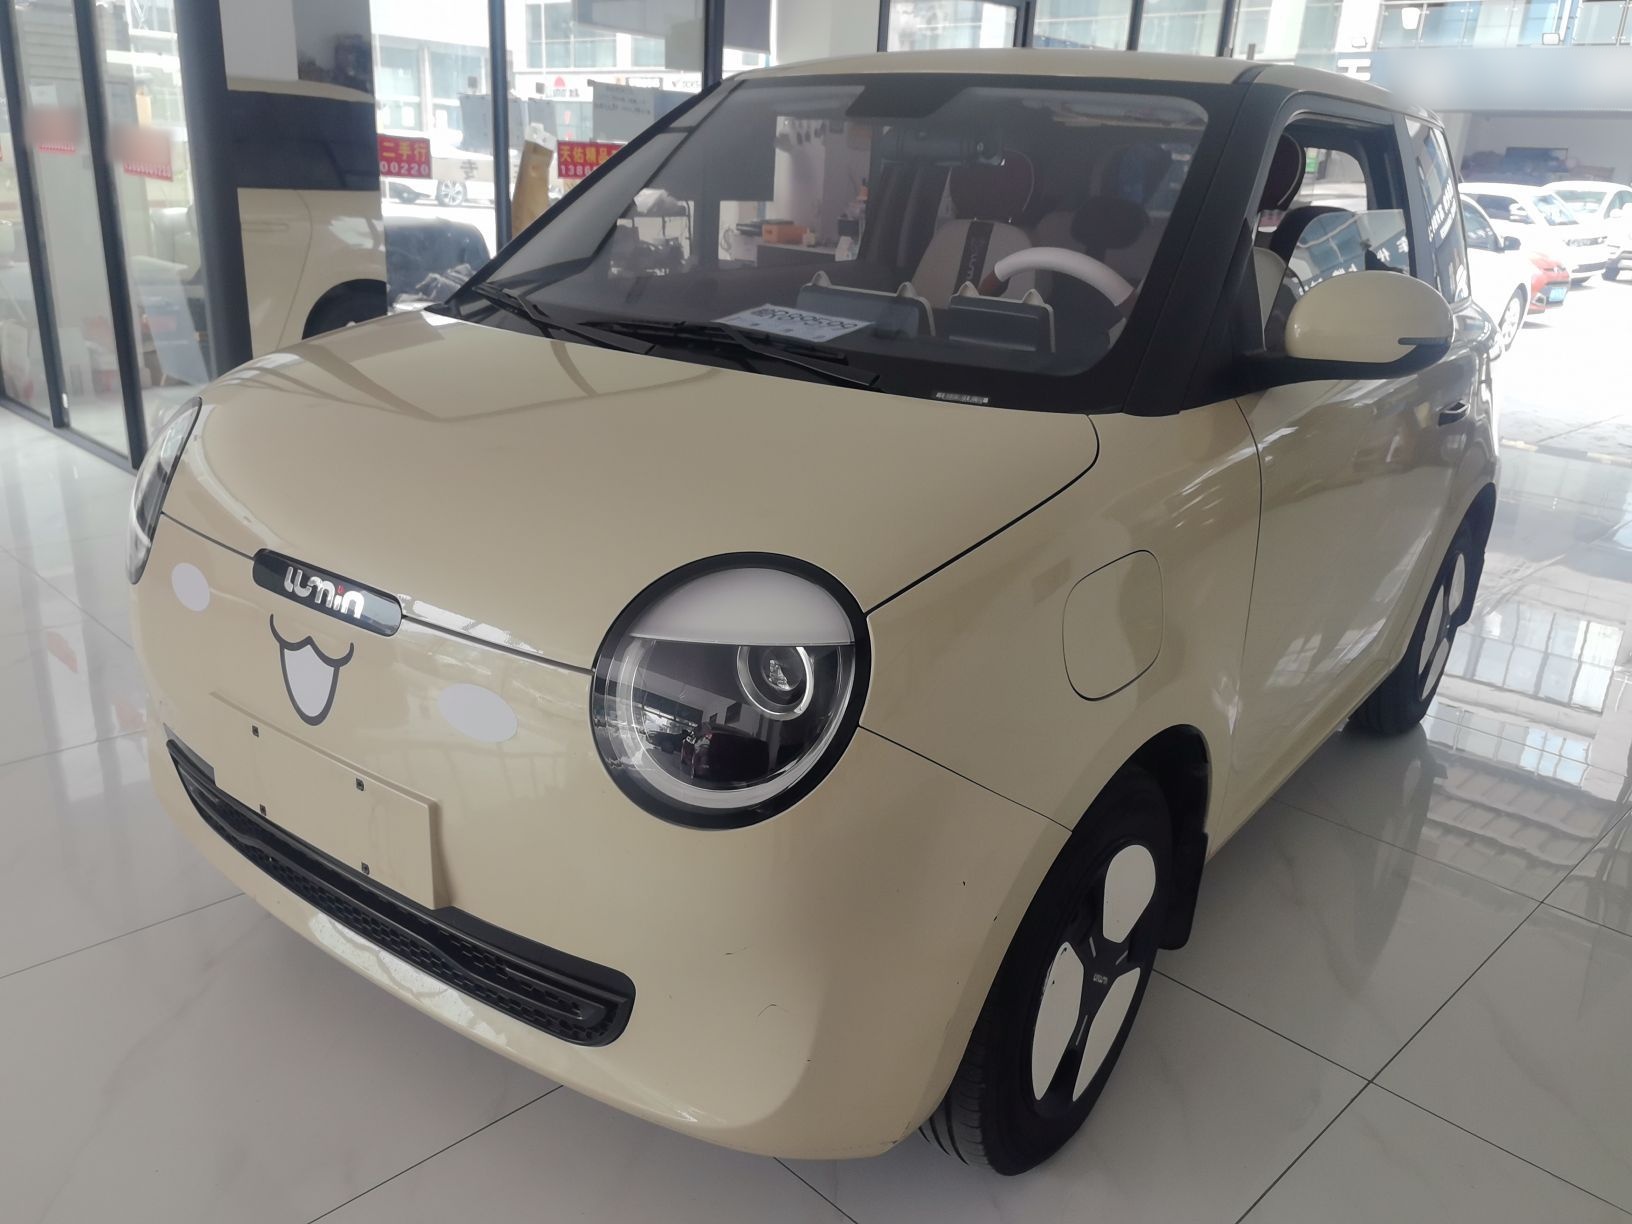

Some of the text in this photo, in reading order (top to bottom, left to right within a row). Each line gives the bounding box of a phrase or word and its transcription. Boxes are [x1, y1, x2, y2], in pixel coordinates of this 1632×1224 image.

[560, 146, 616, 164] 天佑精品
[380, 161, 429, 175] 00220
